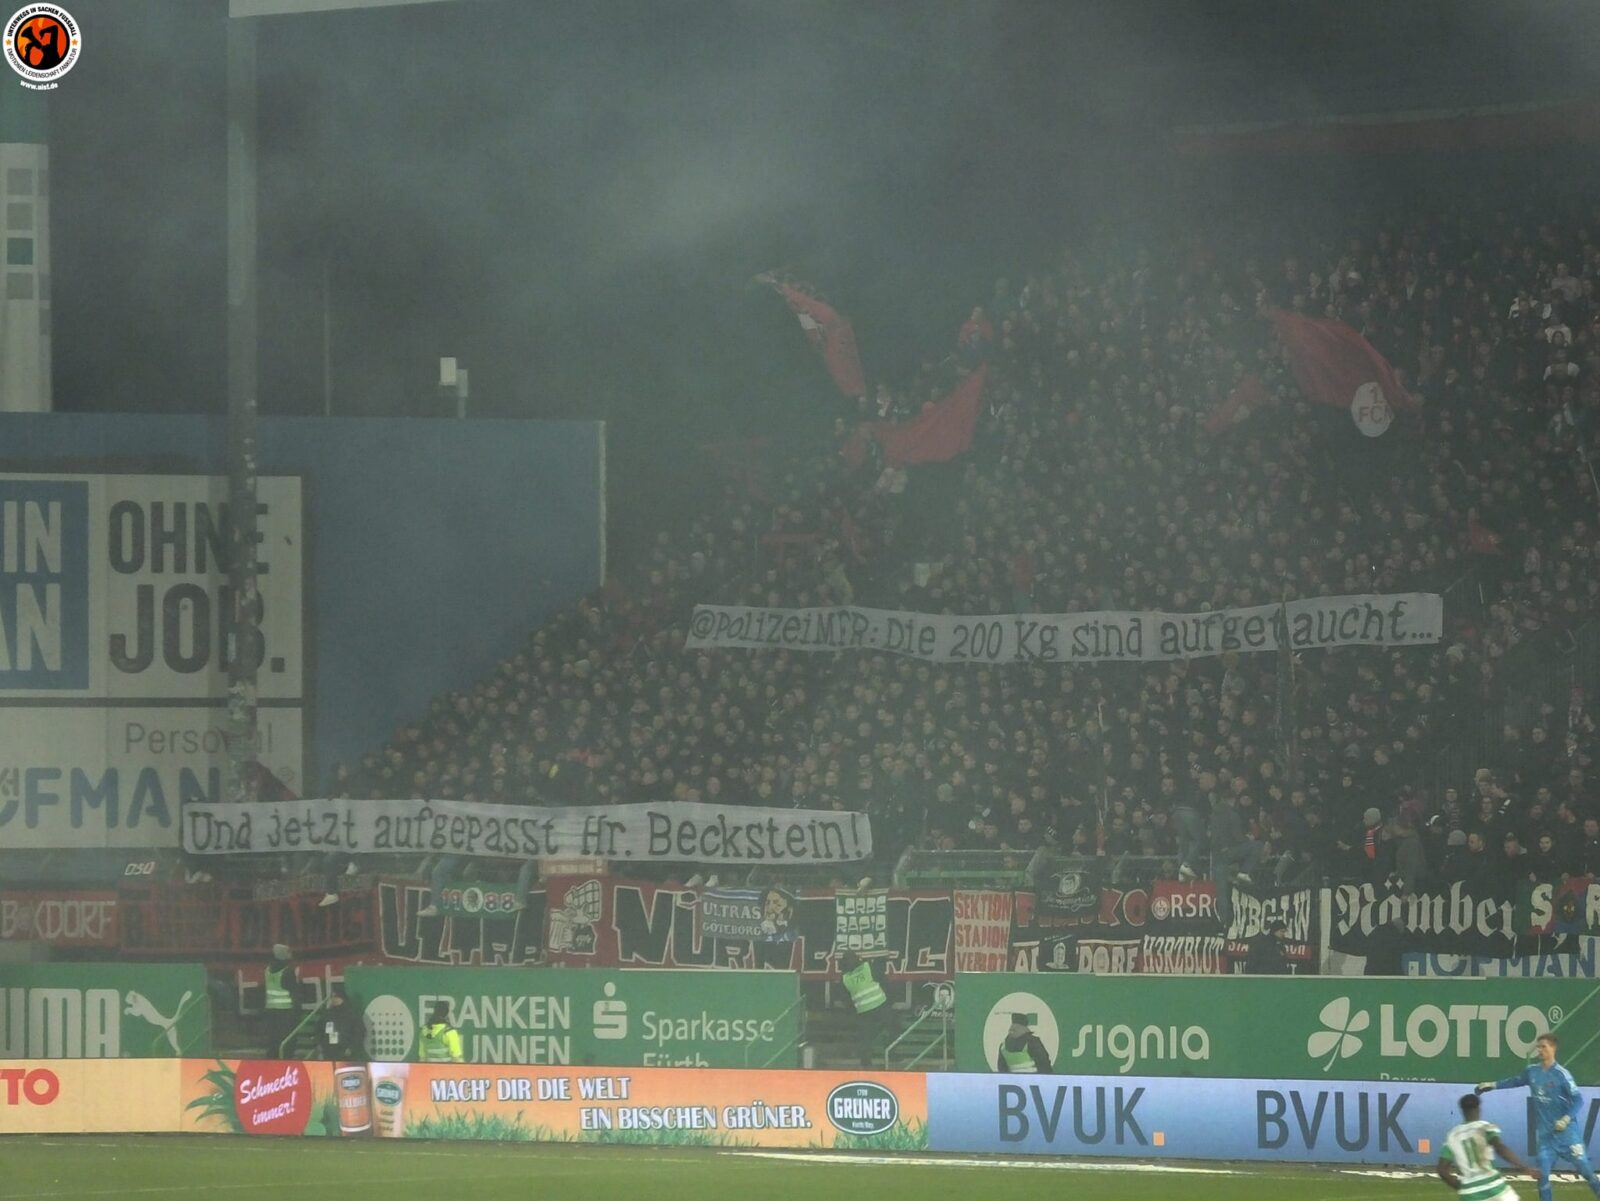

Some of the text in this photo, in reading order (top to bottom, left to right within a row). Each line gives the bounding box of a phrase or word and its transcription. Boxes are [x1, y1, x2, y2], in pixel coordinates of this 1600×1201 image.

[886, 617, 936, 655] Die
[950, 621, 1002, 659] 200
[1072, 617, 1142, 657] sind
[188, 810, 252, 850] Und
[267, 807, 358, 849] jetzt
[374, 806, 559, 857] aufgepasst
[647, 811, 863, 859] Beckstein!
[703, 902, 761, 920] ULTRAS
[836, 932, 888, 950] 2004
[418, 995, 570, 1030] FRANKEN
[642, 1011, 775, 1048] Sparkasse
[1072, 1024, 1210, 1074] signia
[1380, 1004, 1549, 1059] LOTTO
[240, 1066, 298, 1104] Schmeckt
[497, 1078, 532, 1101] DIR
[537, 1078, 572, 1101] DIE
[577, 1077, 630, 1100] WELT
[253, 1091, 297, 1125] immer!
[580, 1101, 812, 1130] EIN BISSCHEN GRÜNER.
